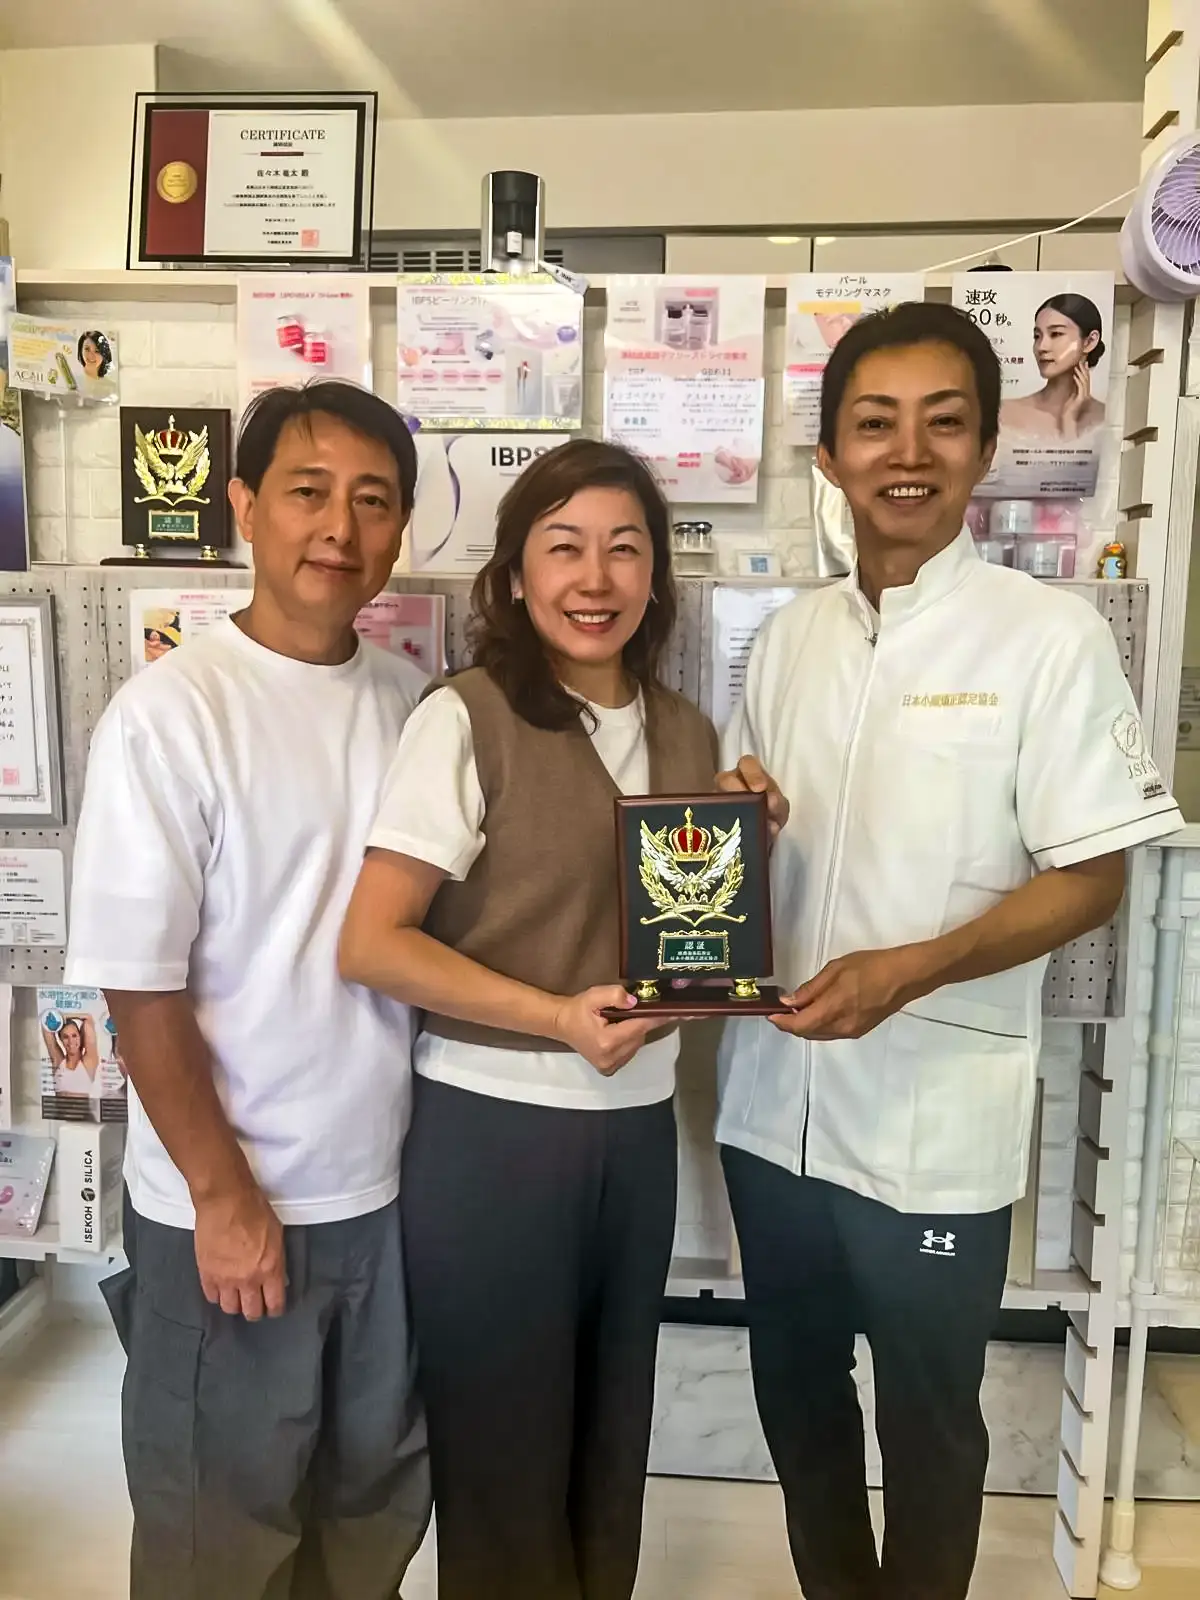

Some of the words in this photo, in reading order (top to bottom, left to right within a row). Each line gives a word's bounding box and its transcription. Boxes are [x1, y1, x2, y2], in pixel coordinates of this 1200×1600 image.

[240, 129, 326, 140] CERTIFICATE
[840, 276, 868, 285] パール
[816, 288, 892, 298] モデリングマスク
[965, 289, 998, 305] 速攻
[84, 1150, 93, 1183] SILICA
[84, 1206, 93, 1243] ISEKOH
